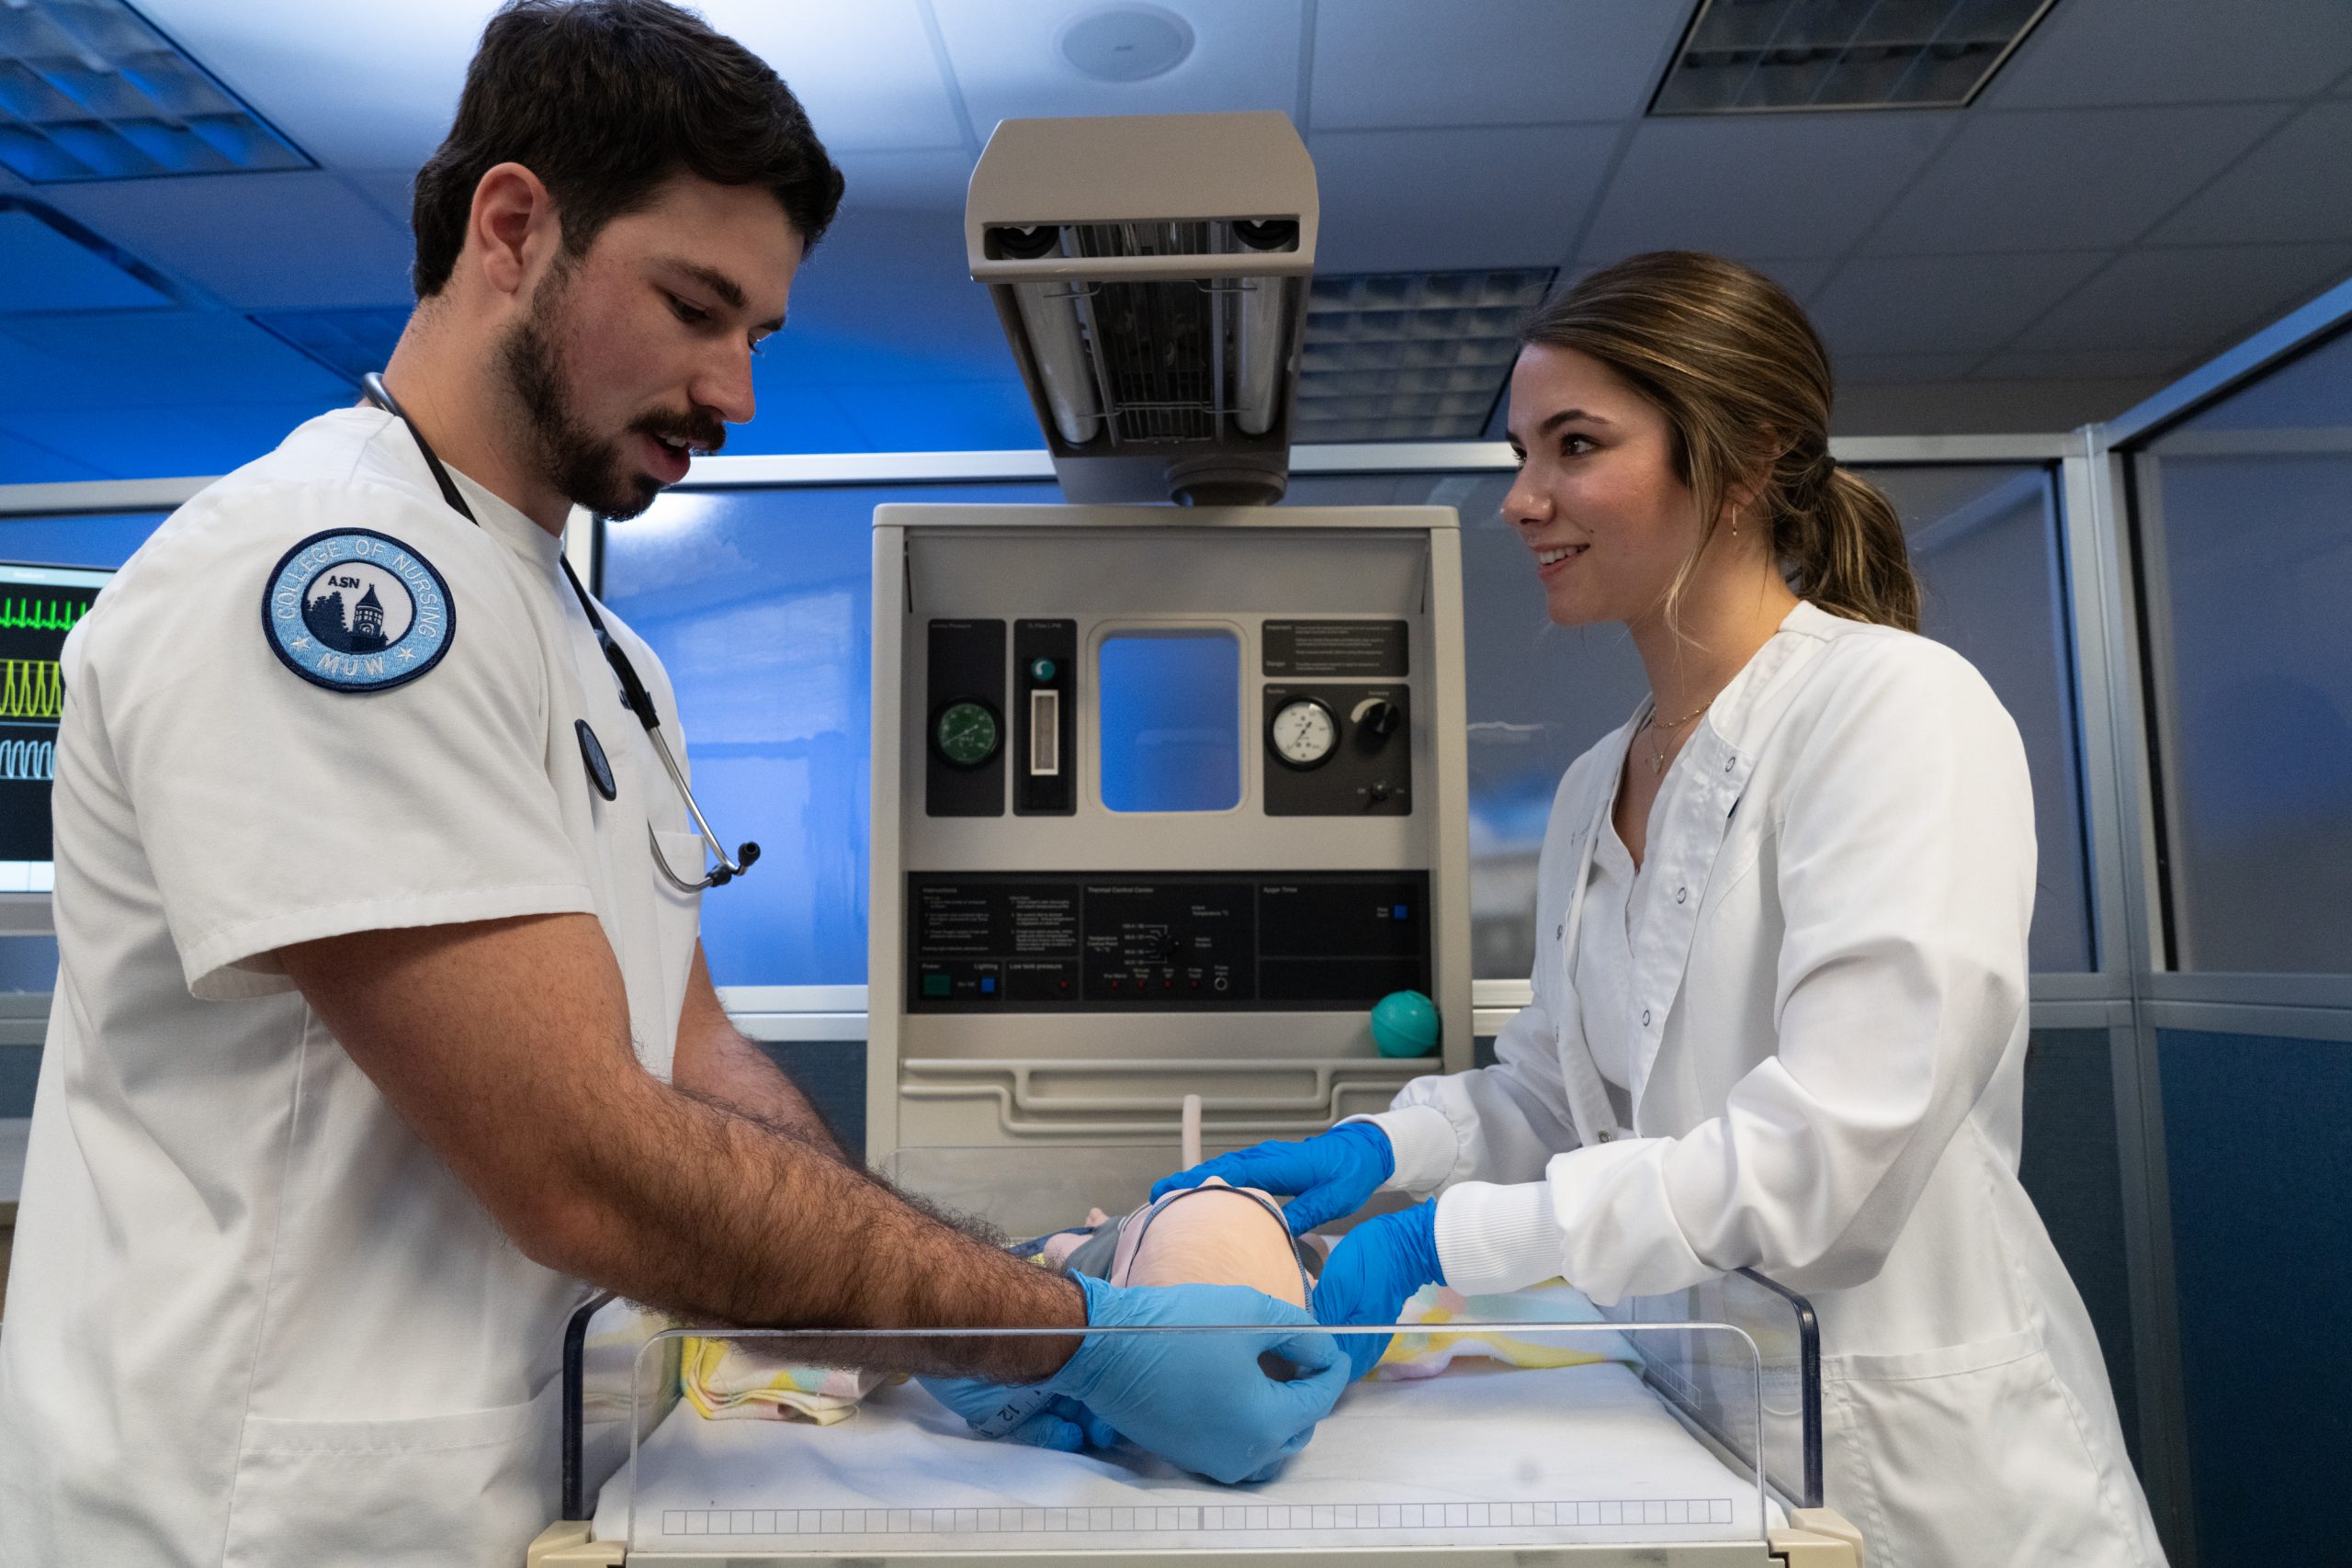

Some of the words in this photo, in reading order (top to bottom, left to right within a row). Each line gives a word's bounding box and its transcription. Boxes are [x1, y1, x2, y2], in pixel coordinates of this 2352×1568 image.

[277, 540, 343, 620] COLLEGE
[355, 539, 386, 557] OF
[391, 554, 442, 638] NURSING
[327, 575, 361, 589] ASN
[316, 652, 384, 677] MUW
[974, 963, 999, 971] Lighting
[997, 1404, 1021, 1422] 12
